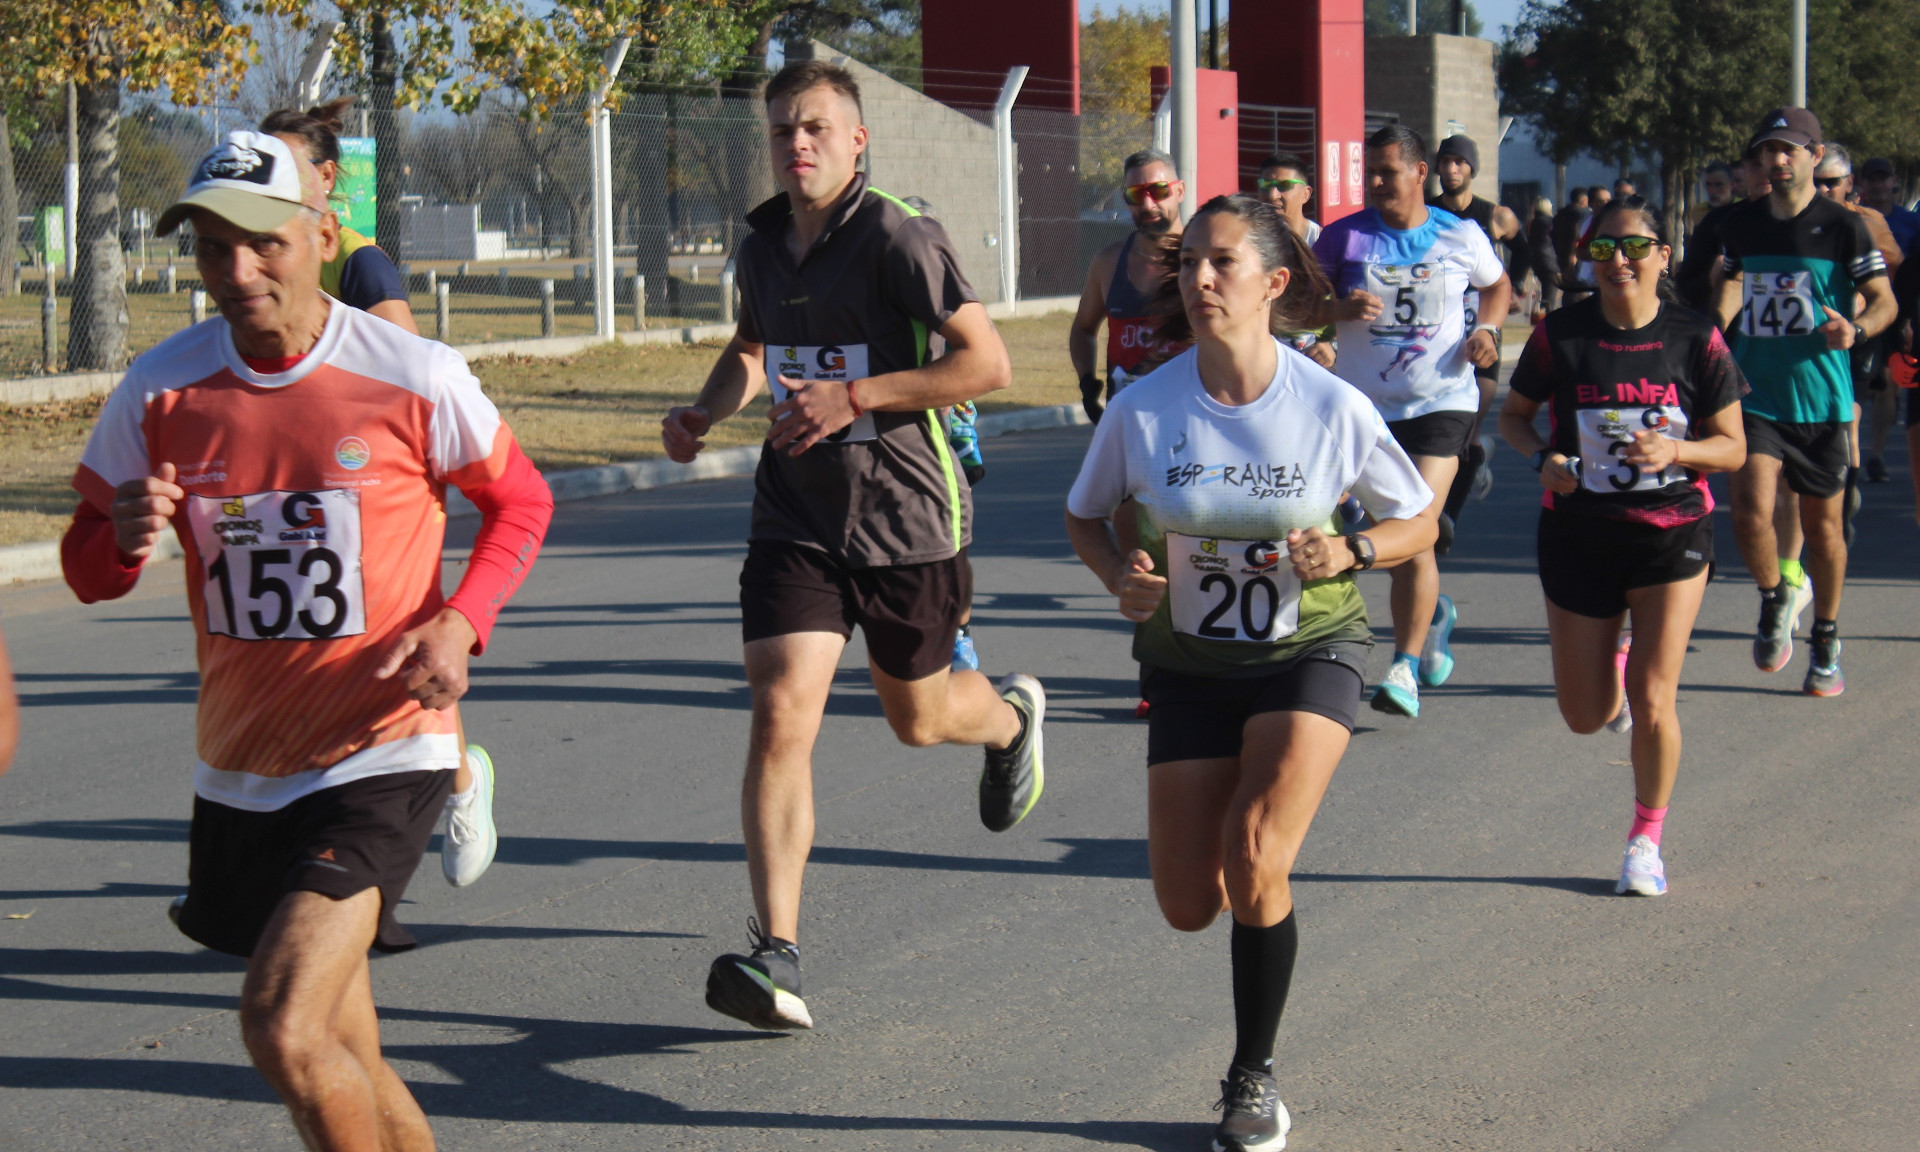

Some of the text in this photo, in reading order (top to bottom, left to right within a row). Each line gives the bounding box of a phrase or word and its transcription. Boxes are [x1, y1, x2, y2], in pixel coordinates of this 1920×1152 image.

[1395, 287, 1418, 324] 5
[1744, 296, 1808, 336] 142
[1625, 341, 1663, 352] running
[1576, 378, 1680, 406] EL INFA
[1248, 486, 1306, 499] Sport
[212, 519, 264, 535] CRONOS
[1189, 554, 1229, 568] CRONOS
[208, 547, 348, 638] 153
[1198, 573, 1279, 640] 20
